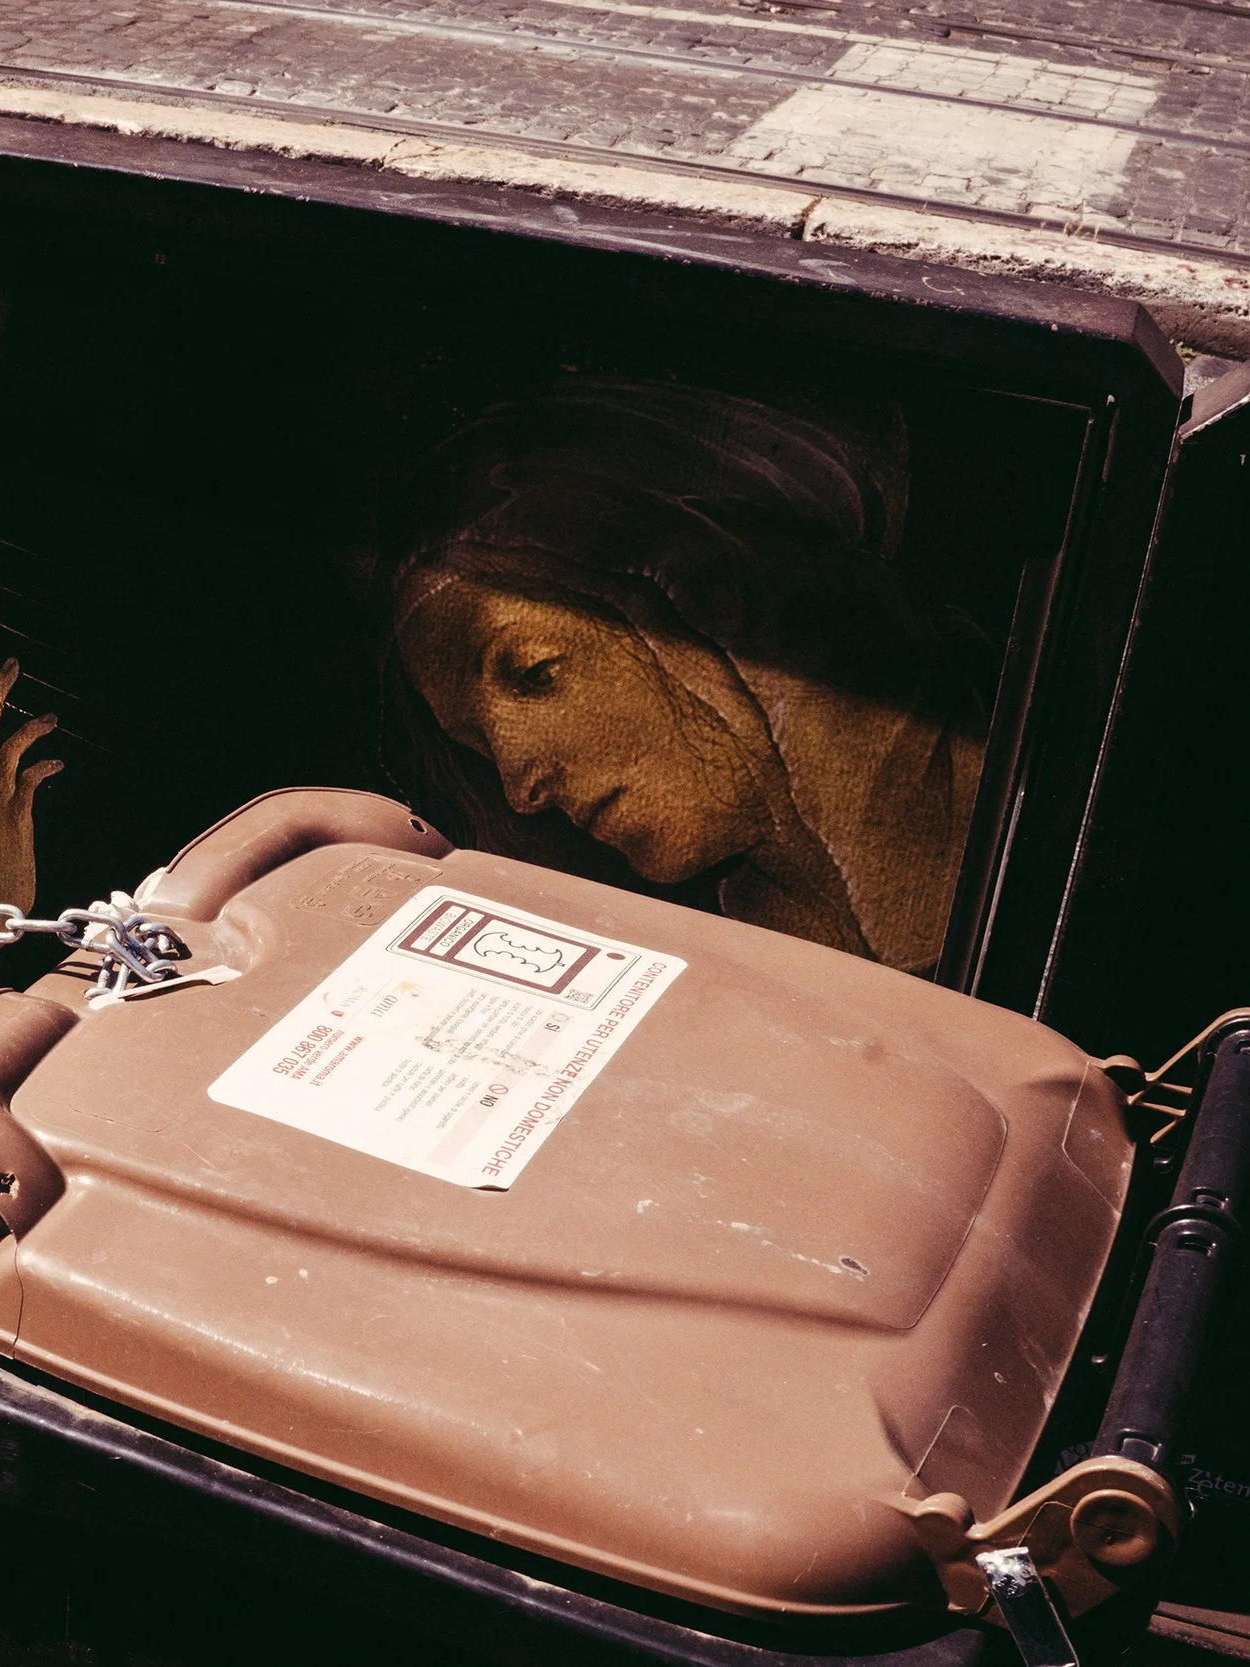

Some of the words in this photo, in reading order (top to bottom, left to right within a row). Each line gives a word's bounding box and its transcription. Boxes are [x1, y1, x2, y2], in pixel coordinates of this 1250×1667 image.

[418, 911, 456, 942] BIOWASTE
[440, 917, 474, 946] ORGANICO
[609, 963, 666, 1019] CONTENITORE
[307, 1025, 332, 1042] 800
[593, 1018, 619, 1038] PER
[292, 1041, 316, 1058] 867
[320, 1030, 344, 1050] numero
[273, 1058, 299, 1075] 035
[304, 1051, 323, 1066] verde
[310, 1036, 364, 1086] www.amaroma.it
[560, 1039, 602, 1078] UTENZE
[292, 1066, 309, 1079] AMA
[541, 1078, 572, 1102] NON
[480, 1095, 498, 1107] NO
[482, 1102, 551, 1176] DOMESTICHE
